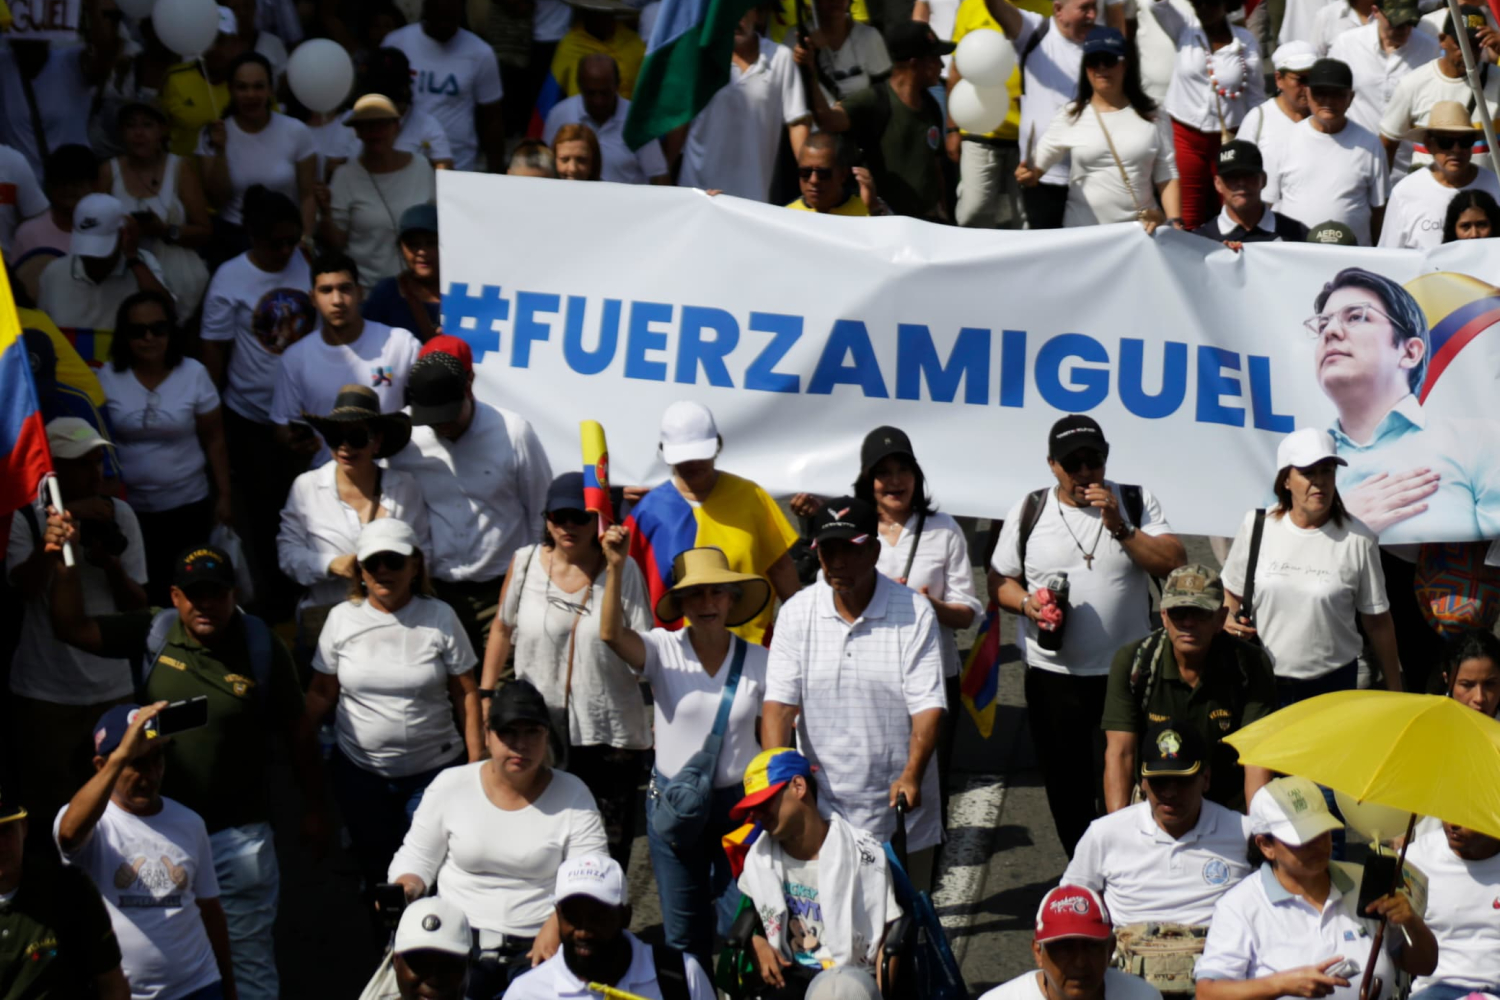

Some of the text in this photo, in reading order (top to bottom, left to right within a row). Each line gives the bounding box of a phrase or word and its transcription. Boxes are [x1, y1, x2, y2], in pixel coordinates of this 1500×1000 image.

[1421, 217, 1444, 231] Cal
[1316, 229, 1343, 240] AERO
[440, 281, 1296, 434] #FUERZAMIGUEL
